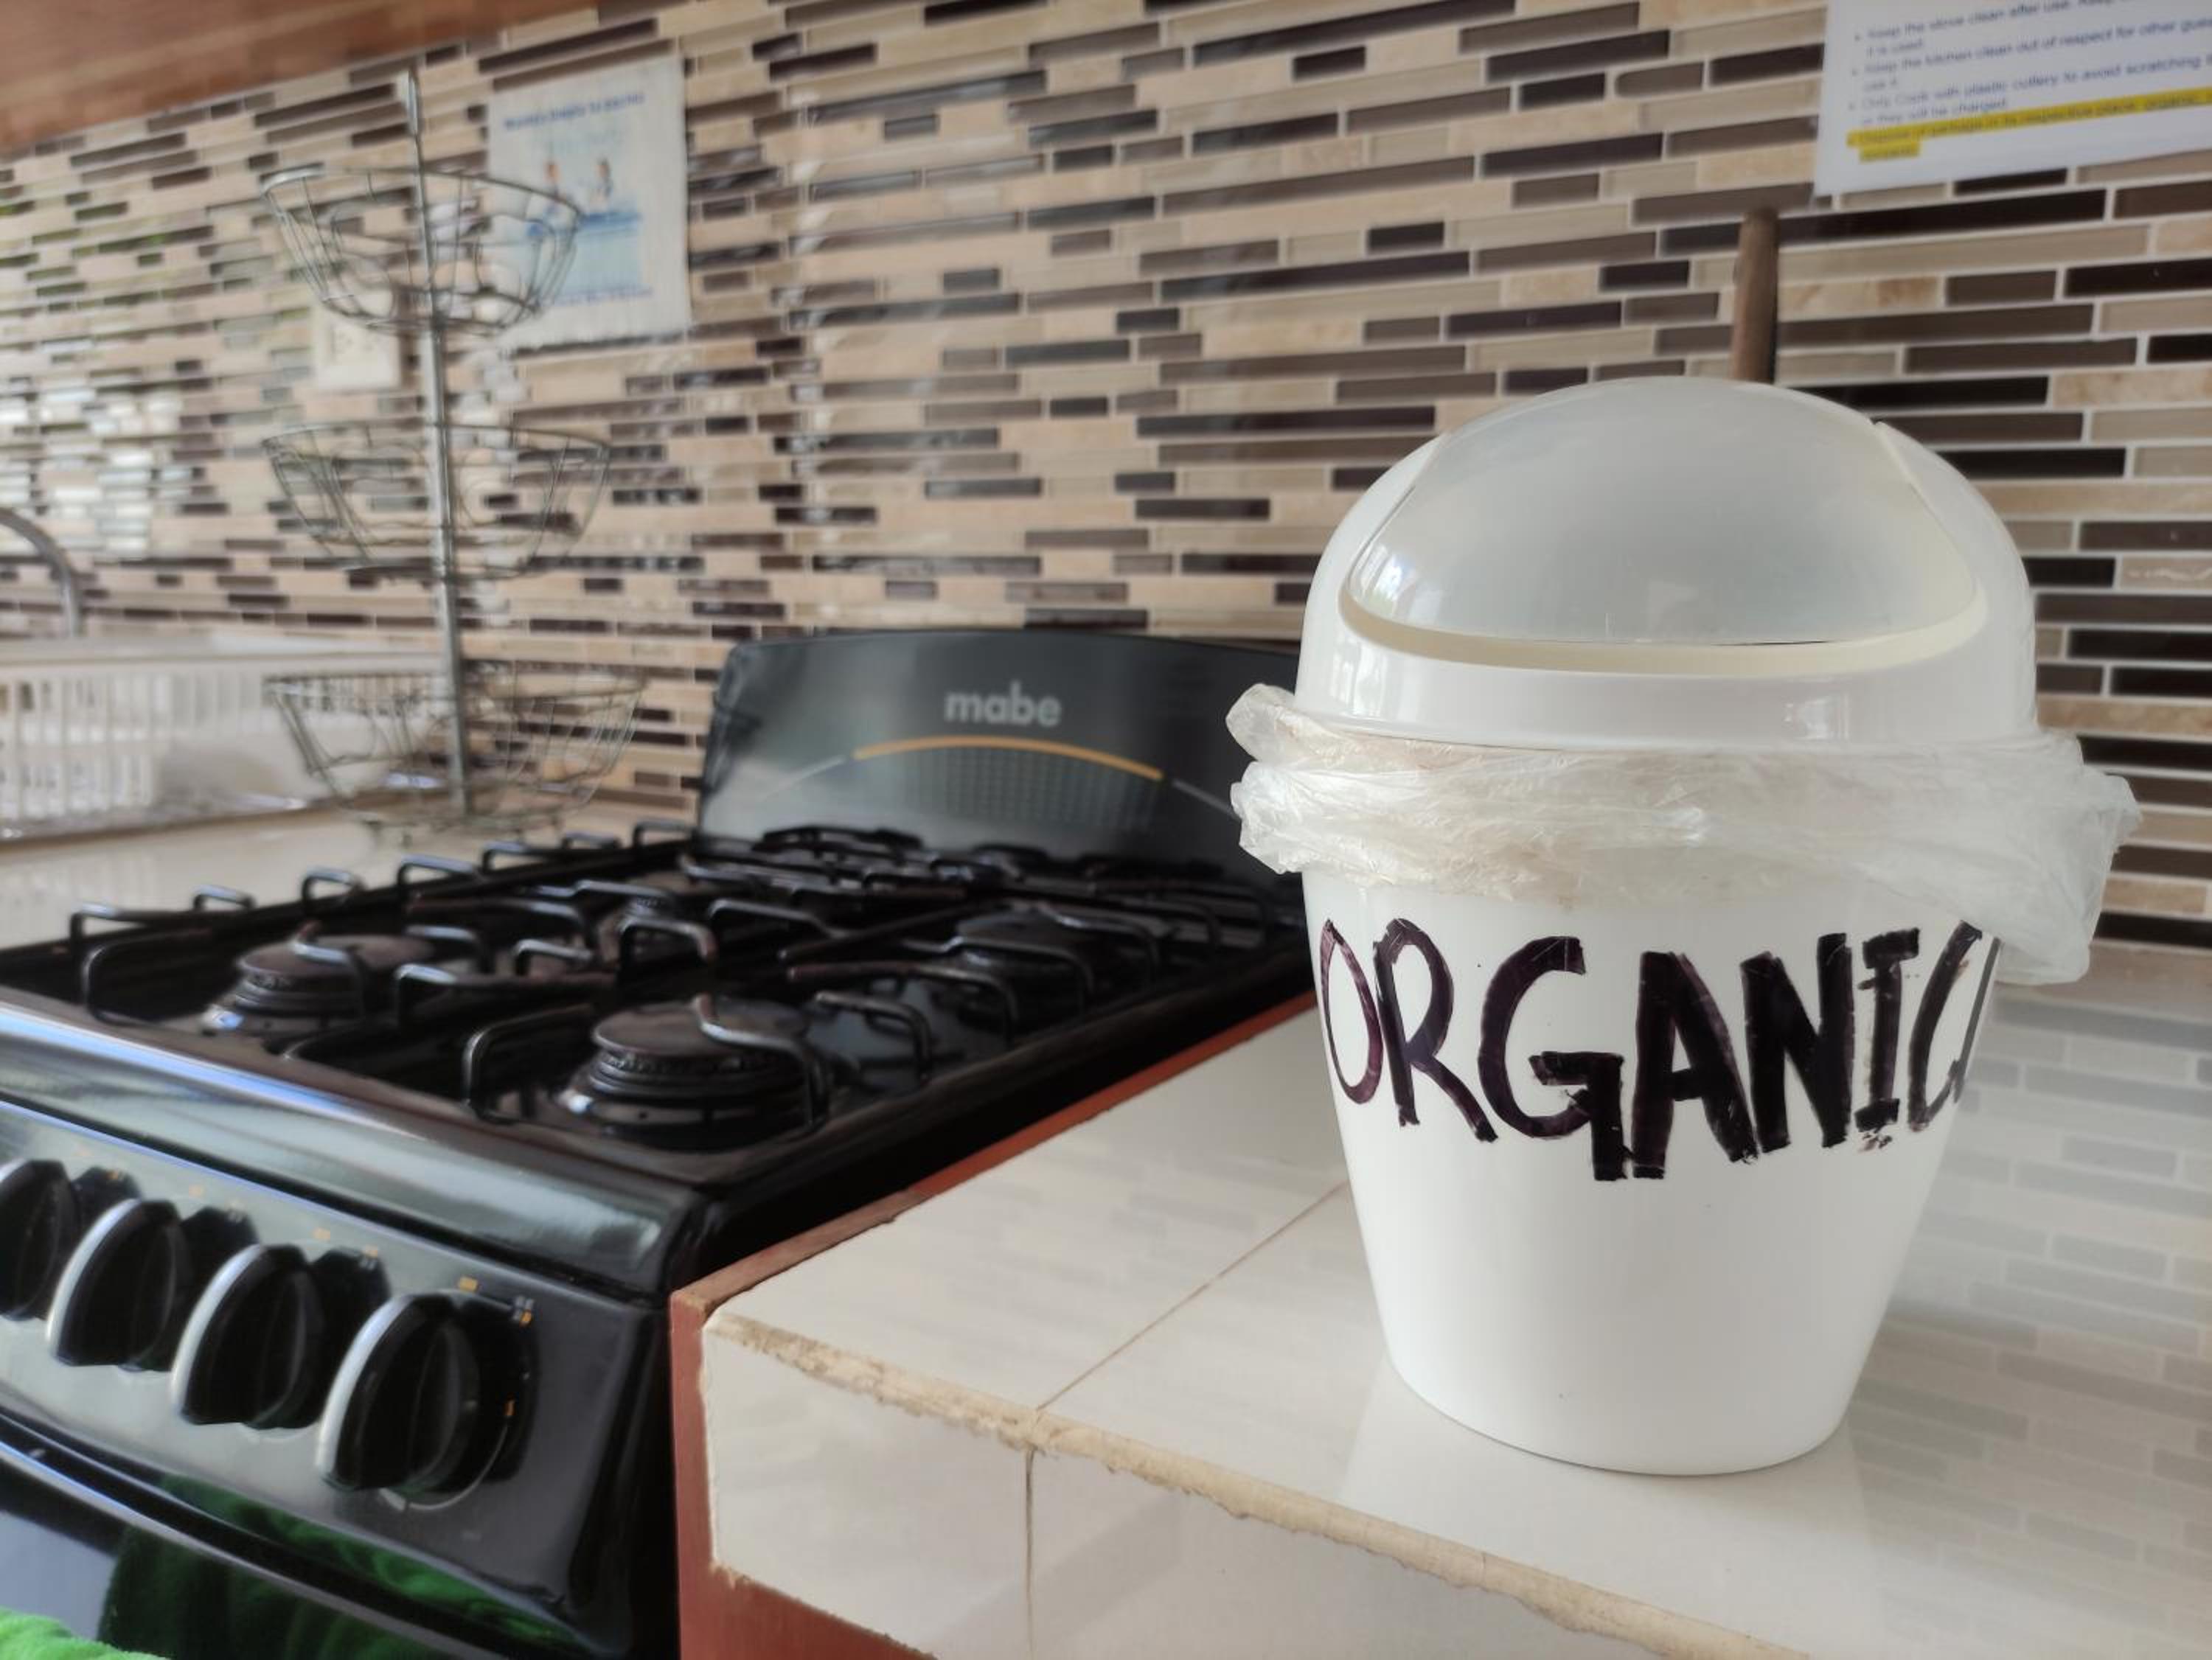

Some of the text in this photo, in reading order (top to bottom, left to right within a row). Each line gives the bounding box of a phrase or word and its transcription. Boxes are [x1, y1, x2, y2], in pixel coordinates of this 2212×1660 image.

[2060, 29, 2112, 46] respect
[2115, 25, 2135, 37] for
[2139, 21, 2175, 35] other
[945, 680, 1062, 727] mabe
